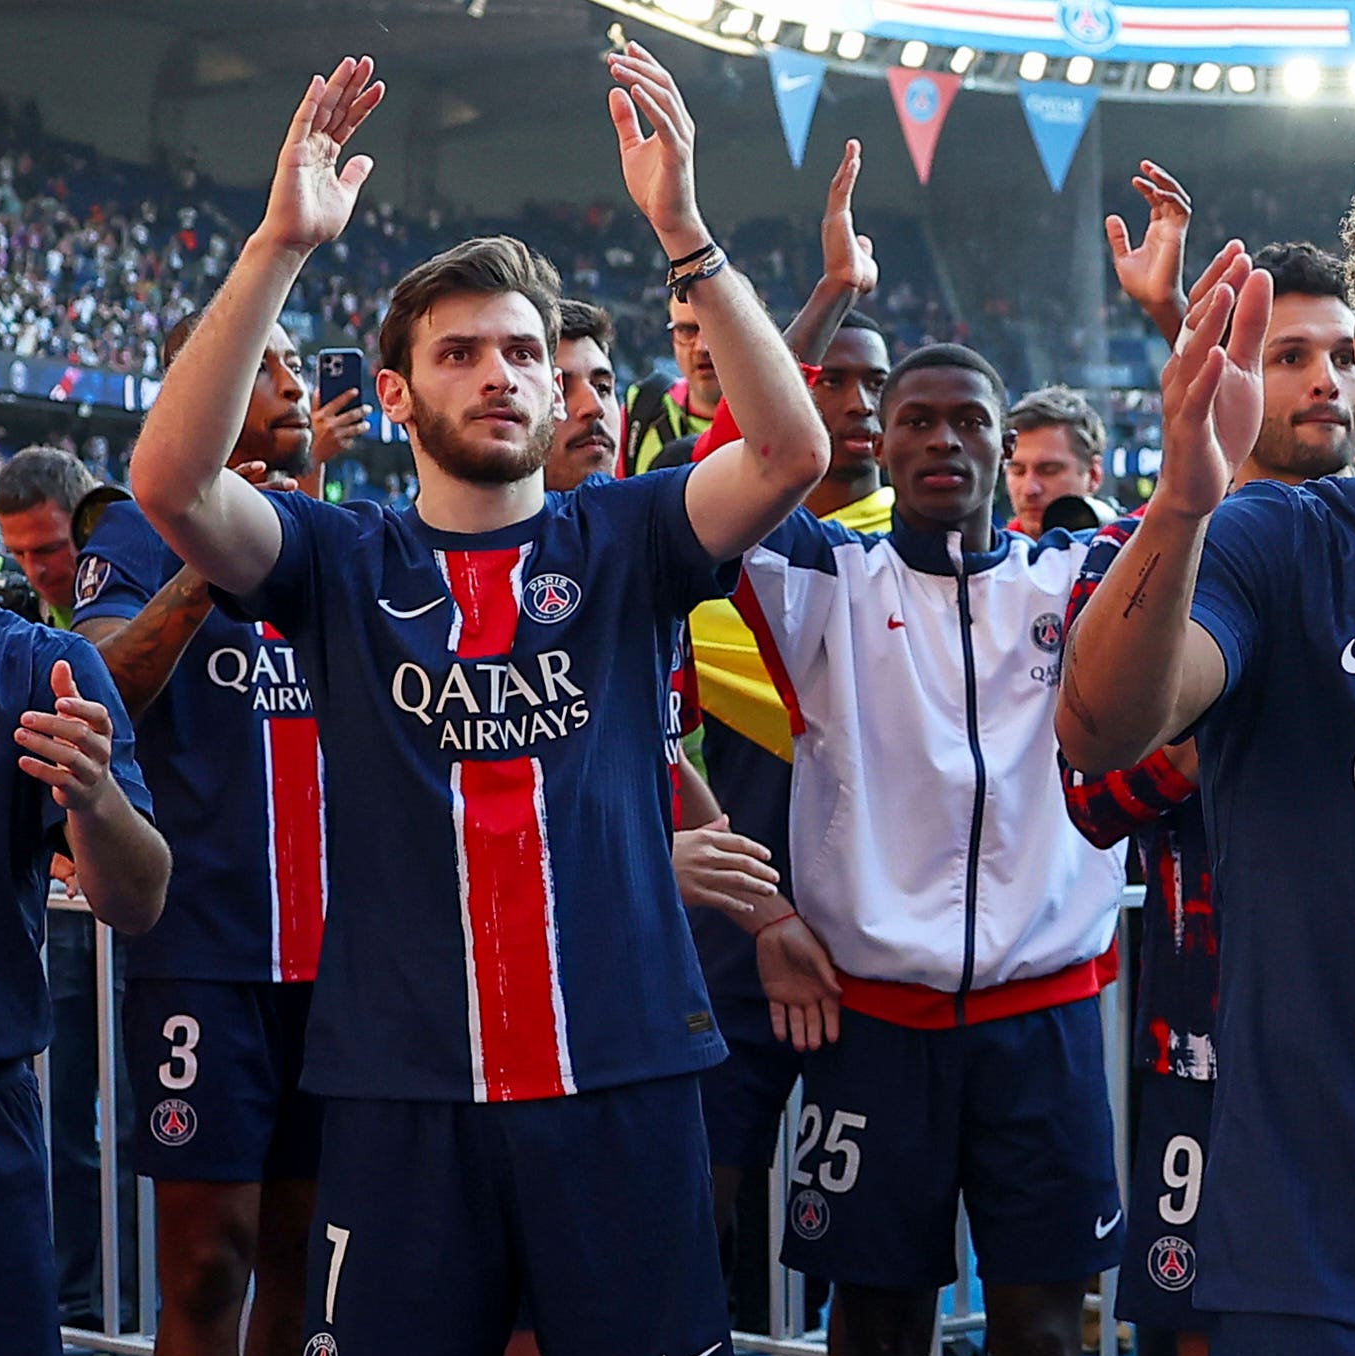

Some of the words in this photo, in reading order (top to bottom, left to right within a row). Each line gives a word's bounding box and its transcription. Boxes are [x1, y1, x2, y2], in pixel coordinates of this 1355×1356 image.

[529, 576, 568, 592] PARIS
[207, 645, 305, 693] QAT
[392, 650, 584, 725] QATAR
[439, 700, 590, 750] AIRWAYS
[158, 1014, 201, 1090] 3
[792, 1103, 867, 1193] 25
[1158, 1134, 1204, 1225] 9
